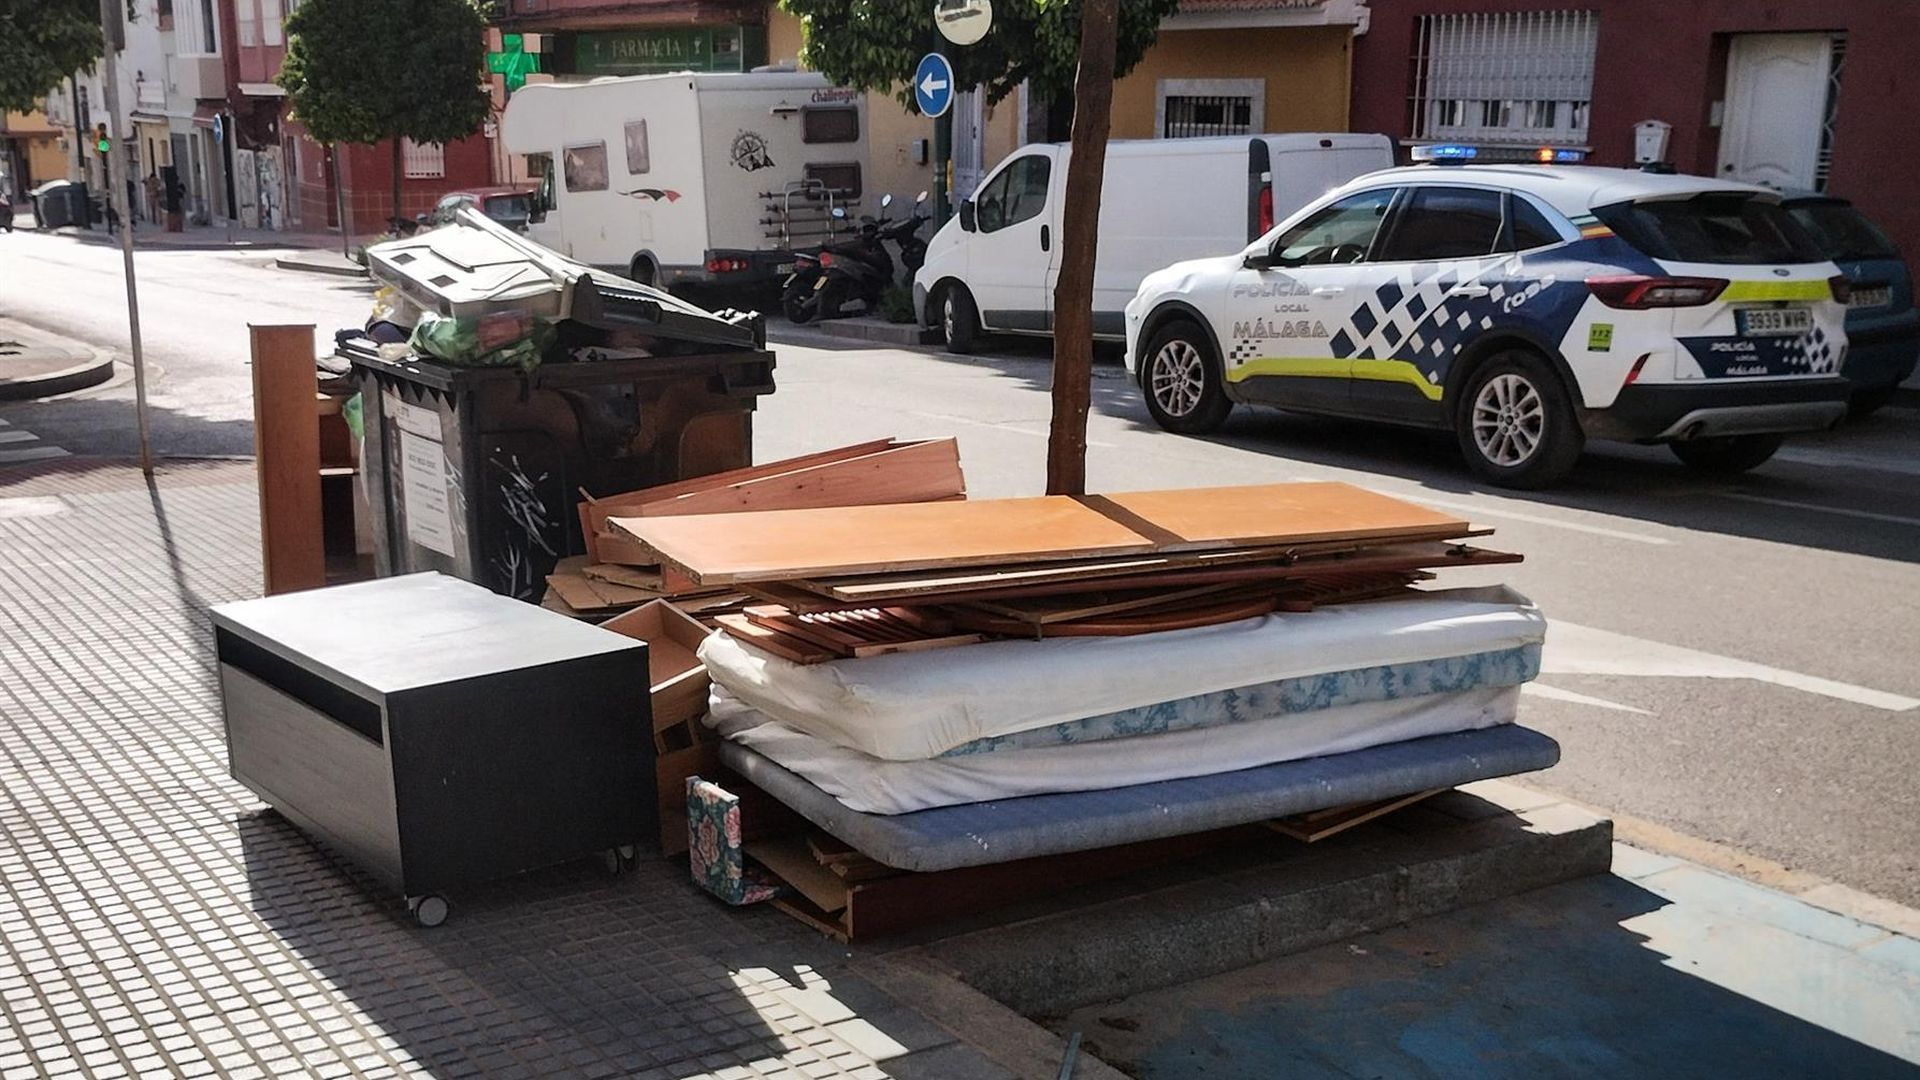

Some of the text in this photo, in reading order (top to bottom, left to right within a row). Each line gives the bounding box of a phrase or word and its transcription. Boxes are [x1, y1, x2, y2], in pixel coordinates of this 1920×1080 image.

[611, 38, 681, 57] FARMACIA
[1274, 304, 1310, 313] LOCAL
[1233, 317, 1329, 339] MÁLAGA
